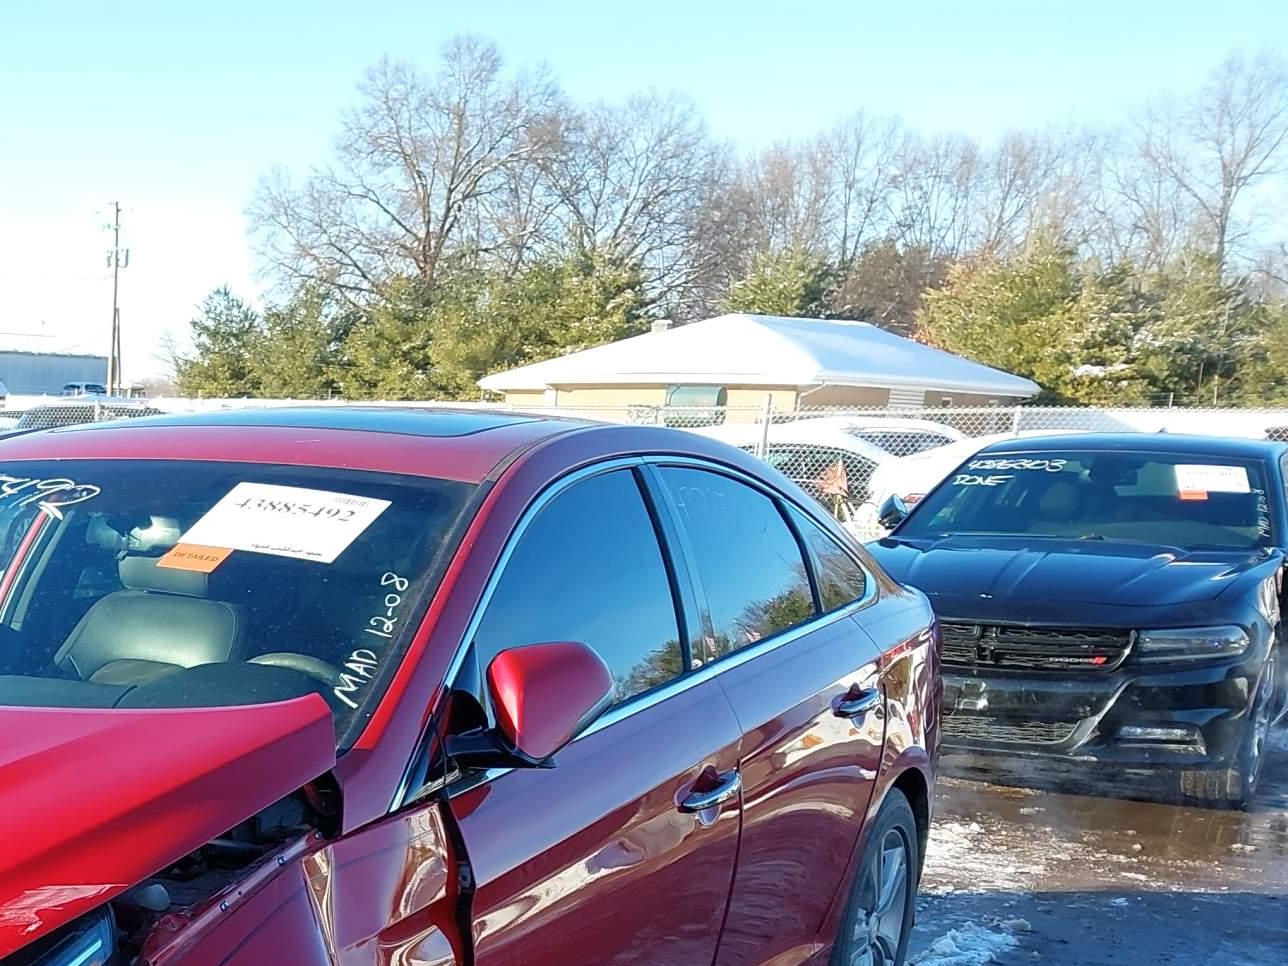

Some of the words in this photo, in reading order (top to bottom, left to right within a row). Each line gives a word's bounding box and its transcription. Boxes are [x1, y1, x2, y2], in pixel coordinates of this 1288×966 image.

[953, 474, 1014, 486] DONE
[236, 497, 355, 522] 43885492
[174, 550, 219, 563] DETAILED
[333, 648, 379, 709] MAD
[365, 571, 409, 639] 12-08
